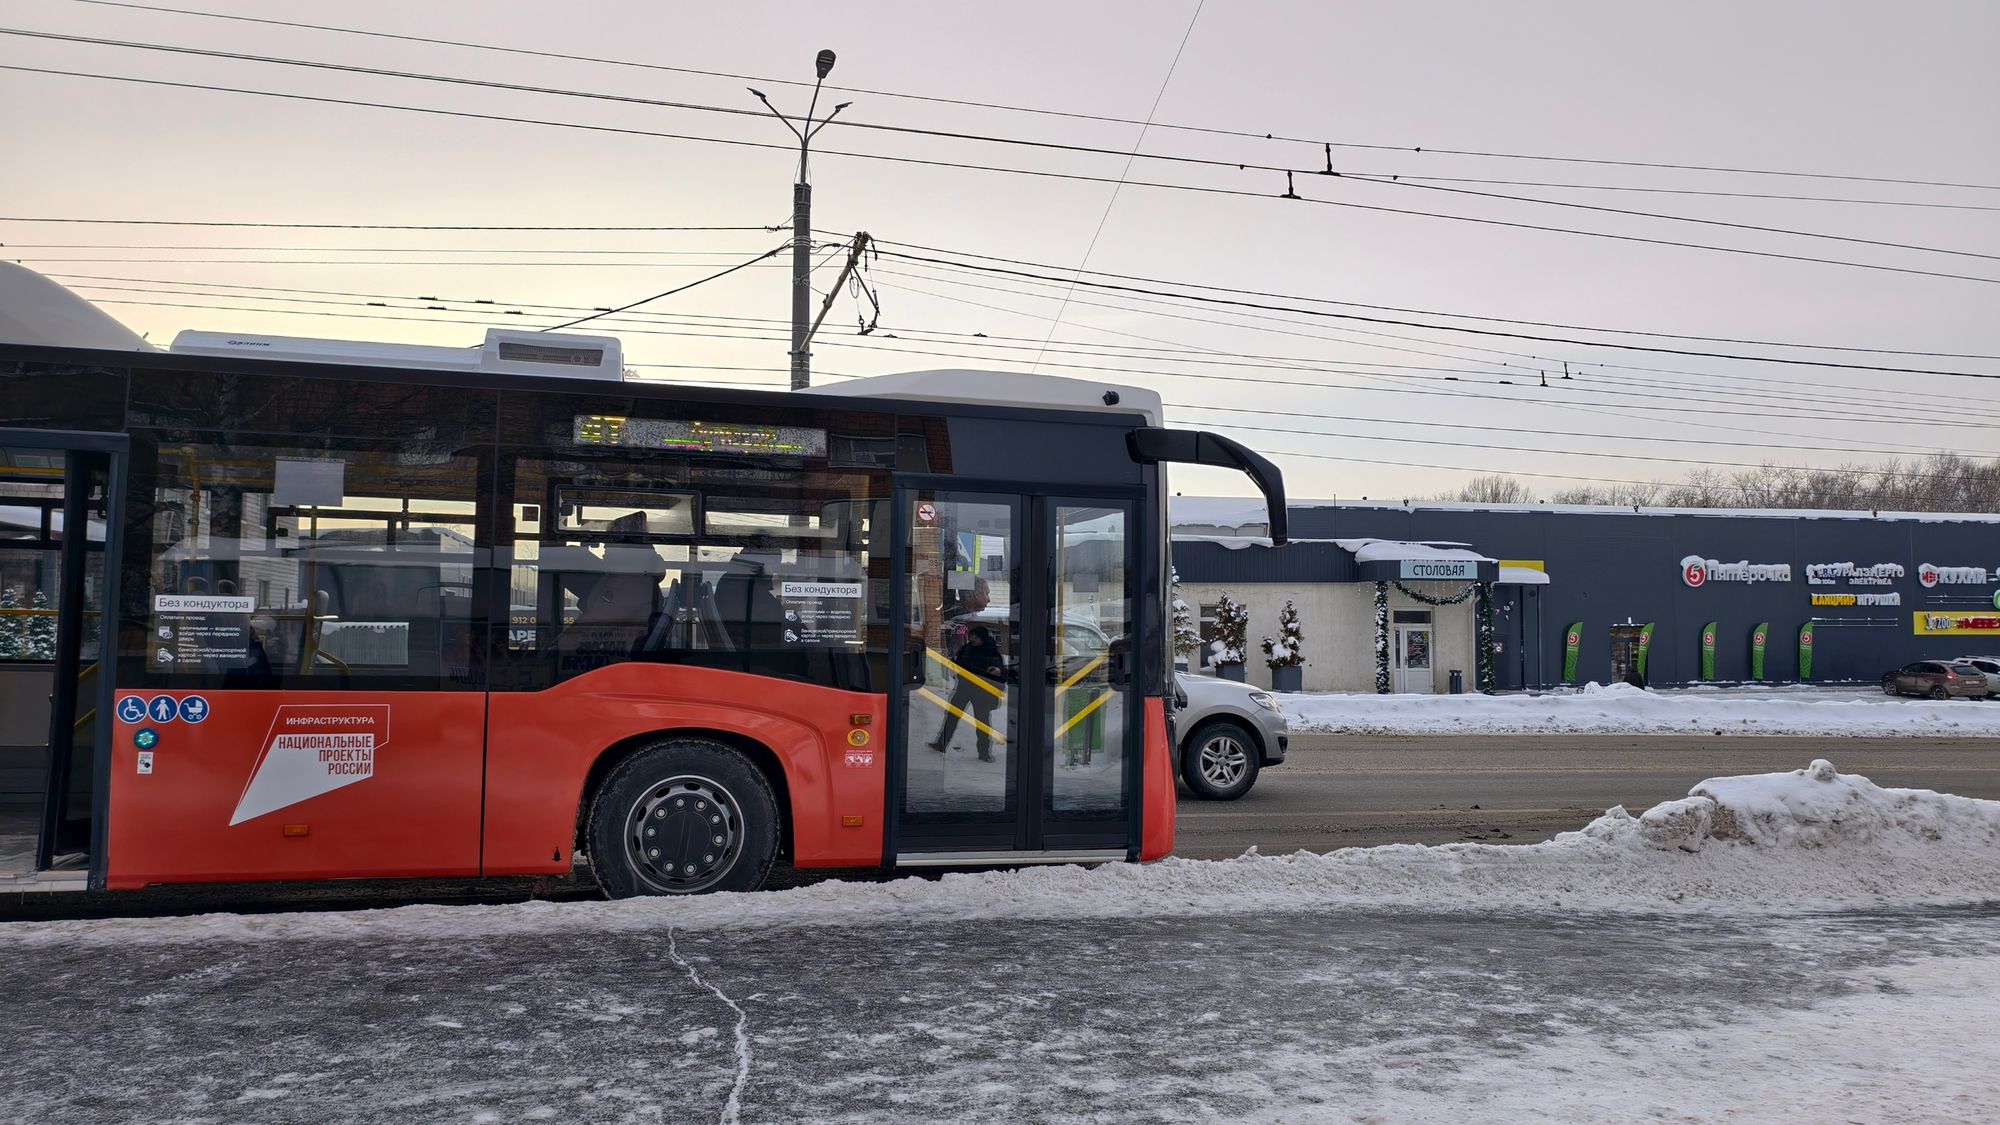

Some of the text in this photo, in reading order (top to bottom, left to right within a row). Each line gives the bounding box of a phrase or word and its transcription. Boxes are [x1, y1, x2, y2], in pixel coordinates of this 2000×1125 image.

[1413, 564, 1465, 577] СТОЛОВАЯ
[1706, 566, 1792, 585] Пятёрочка
[785, 584, 857, 595] Без кондуктора
[159, 597, 249, 610] Без кондуктора
[1811, 594, 1901, 606] КАНЦМИР ИГРУШКИ
[512, 616, 528, 624] 912
[286, 716, 375, 726] ИНФРАСТРУКТУРА
[278, 735, 372, 750] НАЦИОНАЛЬНЫЕ
[318, 749, 372, 762] ПРОЕКТЫ
[327, 763, 371, 776] РОССИИ
